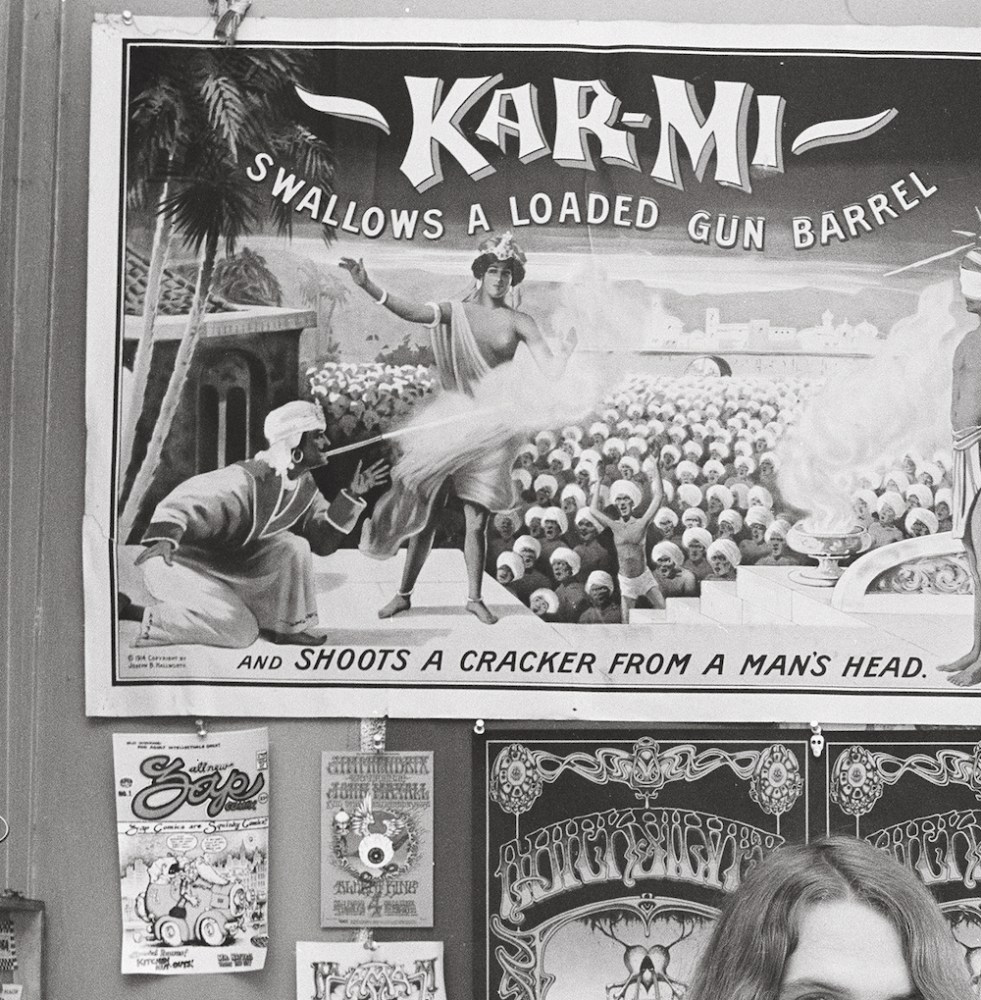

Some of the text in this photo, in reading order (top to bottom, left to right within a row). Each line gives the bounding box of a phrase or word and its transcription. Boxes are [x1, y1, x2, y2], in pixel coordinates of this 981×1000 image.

[400, 73, 786, 194] KAR-MI
[246, 152, 938, 250] SWALLOWS A LOADED GUN BARREL
[237, 648, 928, 679] AND SHOOTS A CRACKER FROM A MAN'S HEAD.
